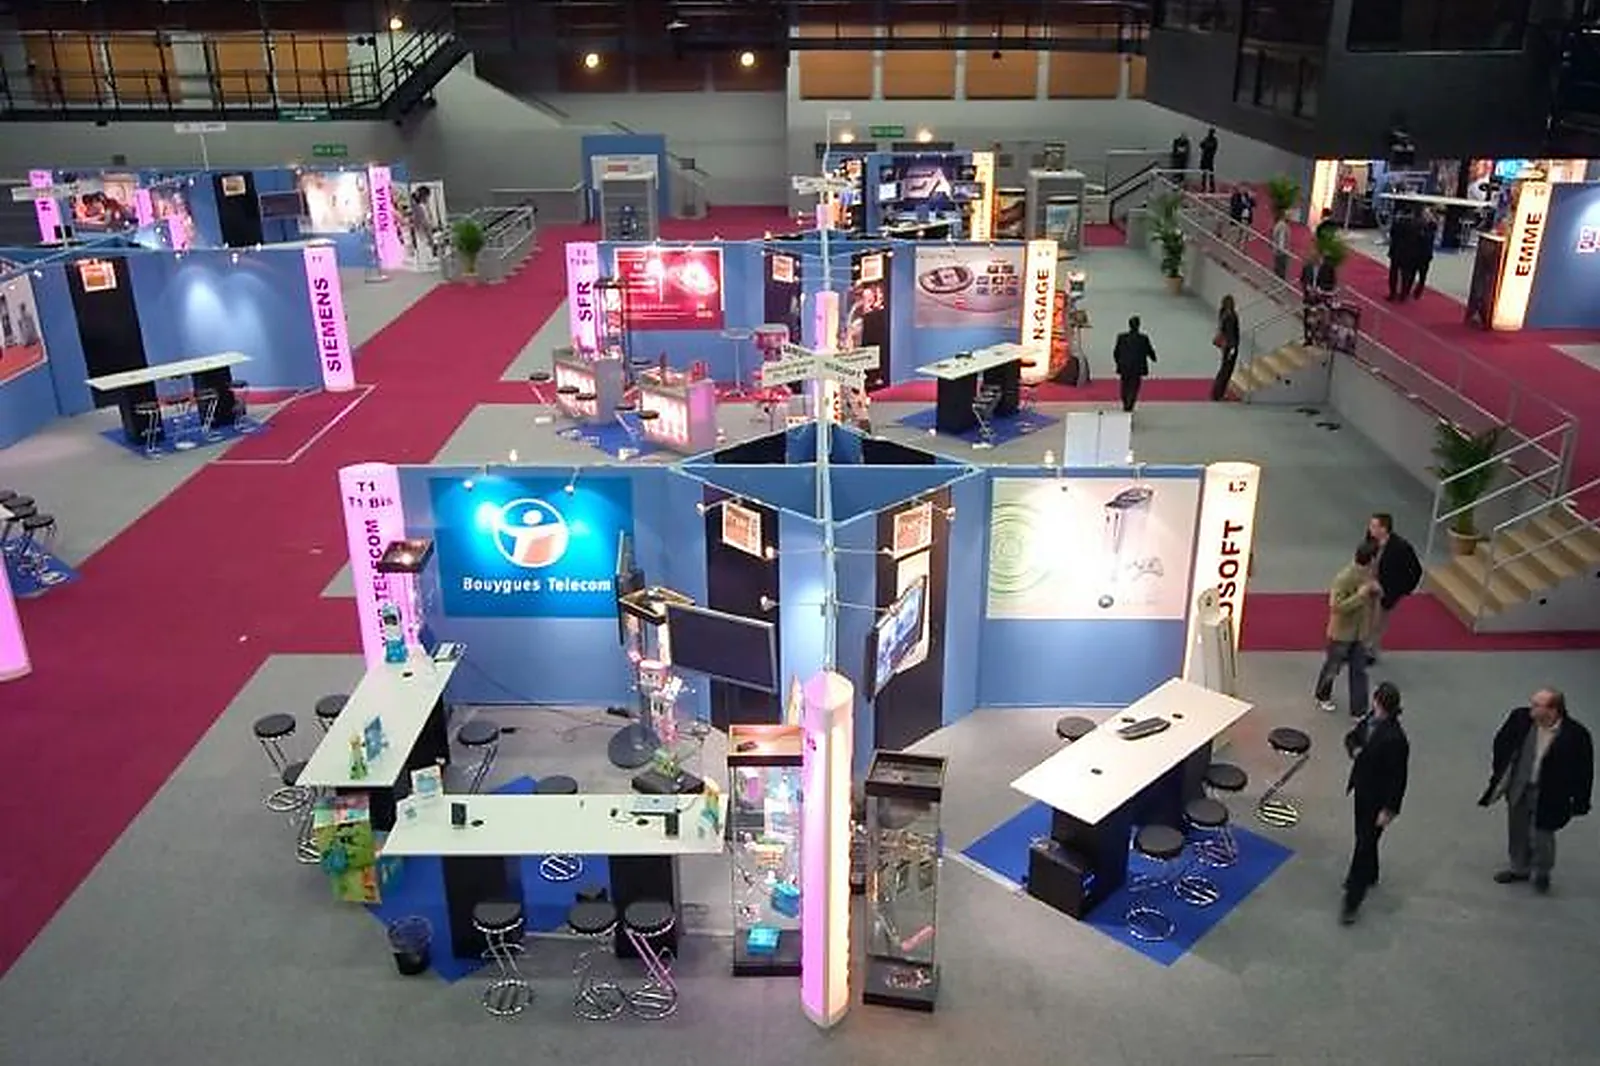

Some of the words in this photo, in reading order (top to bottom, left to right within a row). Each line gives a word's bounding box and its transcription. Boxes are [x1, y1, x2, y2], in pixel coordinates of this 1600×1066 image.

[375, 186, 389, 232] NOKIA
[1515, 212, 1542, 277] EMME
[577, 281, 593, 322] SFR
[312, 277, 342, 372] SIEMENS
[356, 481, 376, 492] T1
[1228, 480, 1247, 492] L2
[348, 496, 363, 508] T1
[462, 577, 541, 594] Bouygues
[548, 577, 611, 592] Telecom
